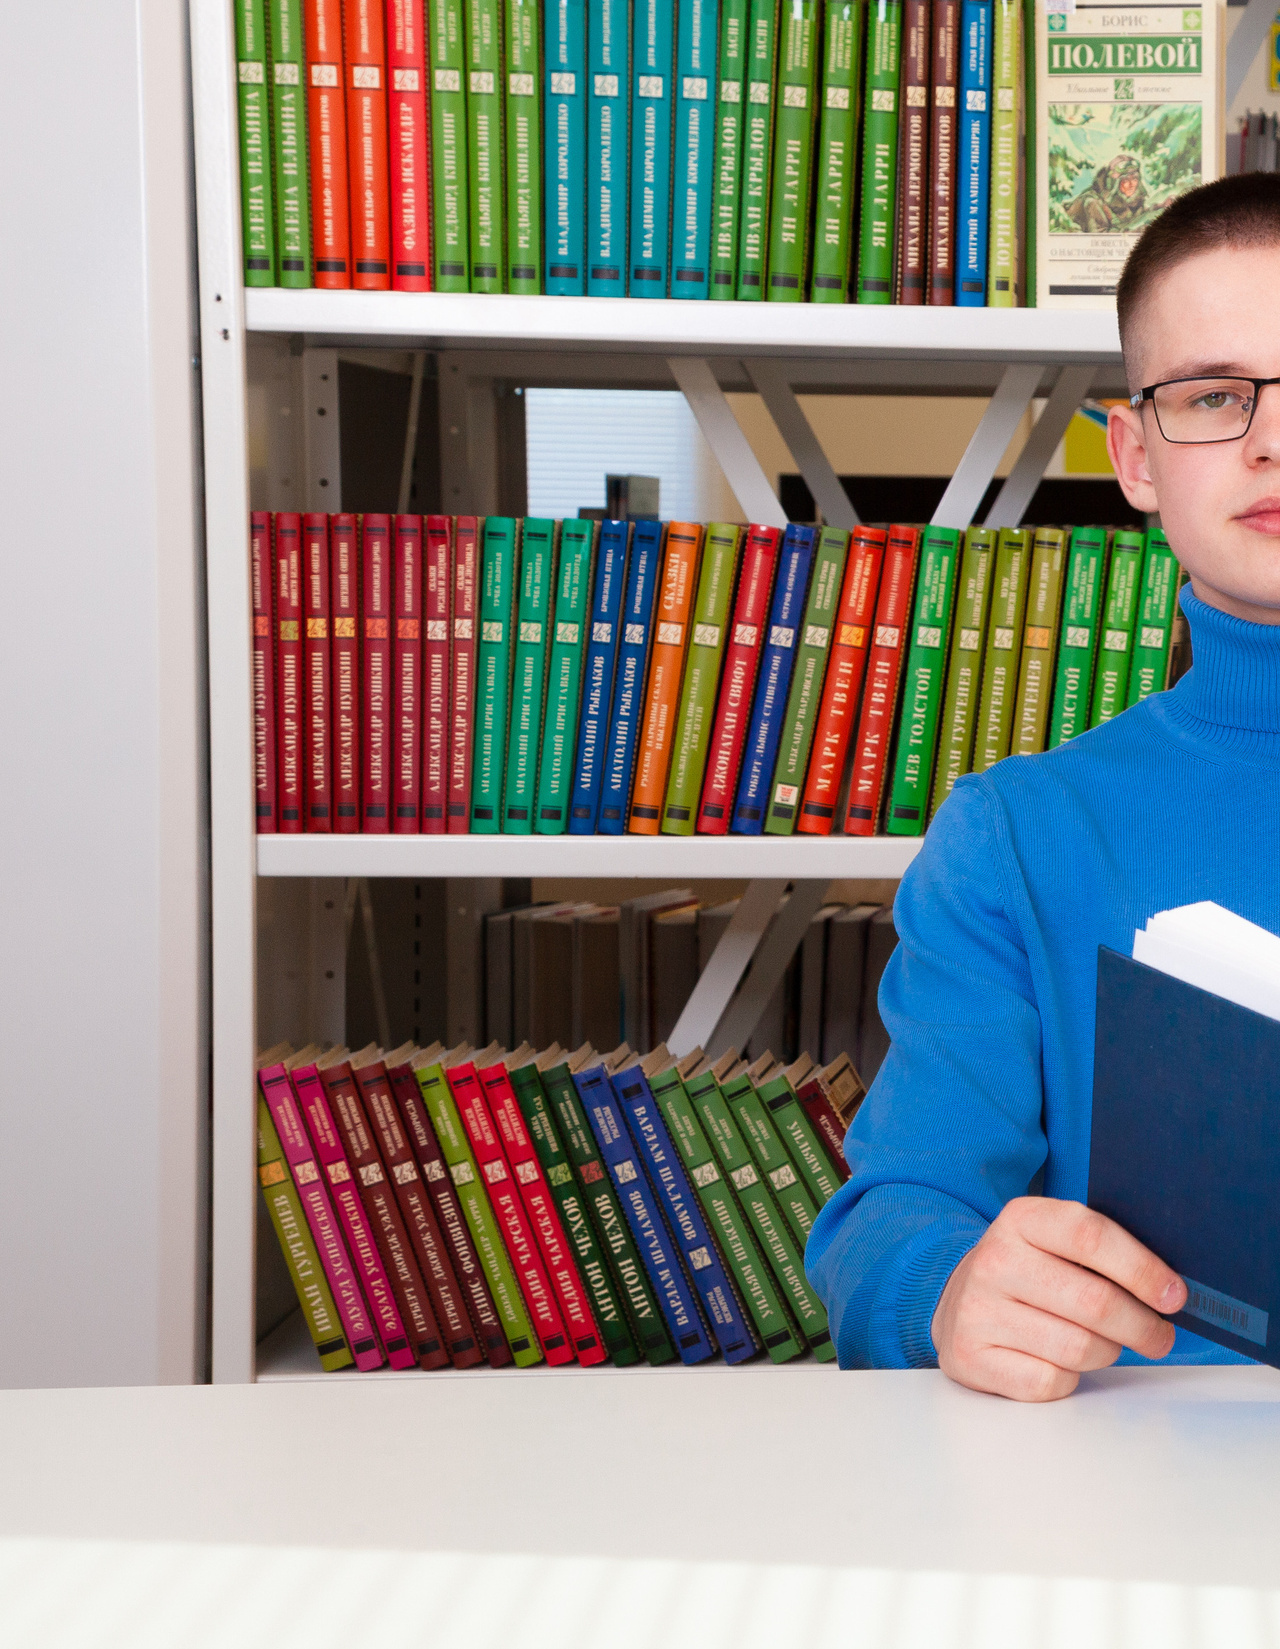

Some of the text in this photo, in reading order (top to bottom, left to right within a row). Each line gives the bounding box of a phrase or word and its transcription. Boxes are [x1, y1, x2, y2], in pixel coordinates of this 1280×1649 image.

[727, 18, 739, 57] БАСНИ
[756, 19, 768, 59] БАСНИ
[1052, 38, 1198, 69] ПОЛЕВОЙ
[1102, 15, 1148, 27] БОРИС
[245, 91, 266, 250] ЕЛЕНА ИЛЬИНА
[281, 92, 300, 251] ЕЛЕНА ИЛЬИНА
[400, 102, 417, 250] ФАЗИЛЬ ИСКАНДЕР
[442, 109, 459, 245] РЕДЬЯРД КИПЛИНГ
[557, 103, 569, 255] ВЛАДИМИР КОРОЛЕНКО
[717, 117, 737, 258] ИВАН КРЫЛОВ
[746, 118, 765, 259] ИВАН КРЫЛОВ
[782, 140, 801, 243] ЯН ЛАРРИ
[873, 143, 890, 247] ЯН ЛАРРИ
[907, 115, 922, 267] МИХАИЛ ЛЕРМОНТОВ
[937, 115, 951, 268] МИХАИЛ ЛЕРМОНТОВ
[967, 119, 980, 271] ДМИТРИЙ МАМИН-СИБИРЯК
[996, 123, 1013, 266] ЮРИЙ ОЛЕША
[663, 553, 680, 609] СКАЗКИ
[781, 592, 791, 619] ОСТРОВ
[284, 655, 298, 794] АЛЕКСАНДР ПУШКИН
[312, 652, 326, 792] АЛЕКСАНДР ПУШКИН
[370, 652, 384, 792] АЛЕКСАНДР ПУШКИН
[429, 653, 444, 793] АЛЕКСАНДР ПУШКИН
[481, 656, 497, 794] АНАТОЛИЙ ПРИСТАВКИН
[580, 656, 605, 791] АНАТОЛИЙ РЫБАКОВ
[712, 657, 746, 794] ДЖОНАТАН СВИФТ
[747, 655, 781, 797] РОБЕРТ ЛЬЮИС СТИВЕНСОН
[788, 658, 816, 774] АЛЕКСАНДР ТВАРДОВСКИЙ
[816, 661, 853, 791] МАРК ТВЕН
[858, 661, 891, 792] МАРК ТВЕН
[905, 668, 931, 788] ЛЕВ ТОЛСТОЙ
[946, 668, 972, 790] ИВАН ТУРГЕНЕВ
[406, 1098, 428, 1146] НЕДОРОСЛЬ
[634, 1105, 696, 1240] ВАРЛАМ ШАЛАМОВ
[274, 1194, 333, 1332] ИВАН ТУРГЕНЕВ
[307, 1190, 365, 1331] ЭДУАРД УСПЕНСКИЙ
[374, 1193, 428, 1333] ГЕРБЕРТ ДЖОРДЖ УЭЛЛС
[438, 1191, 497, 1326] ДЕНИС ФОНВИЗИН
[531, 1195, 586, 1323] ЛИДИЯ ЧАРСКАЯ
[562, 1196, 619, 1322] АНТОН ЧЕХОВ
[628, 1190, 689, 1326] ВАРЛАМ ШАЛАМОВ
[712, 1199, 774, 1318] УИЛЬЯМ ШЕКСПИР
